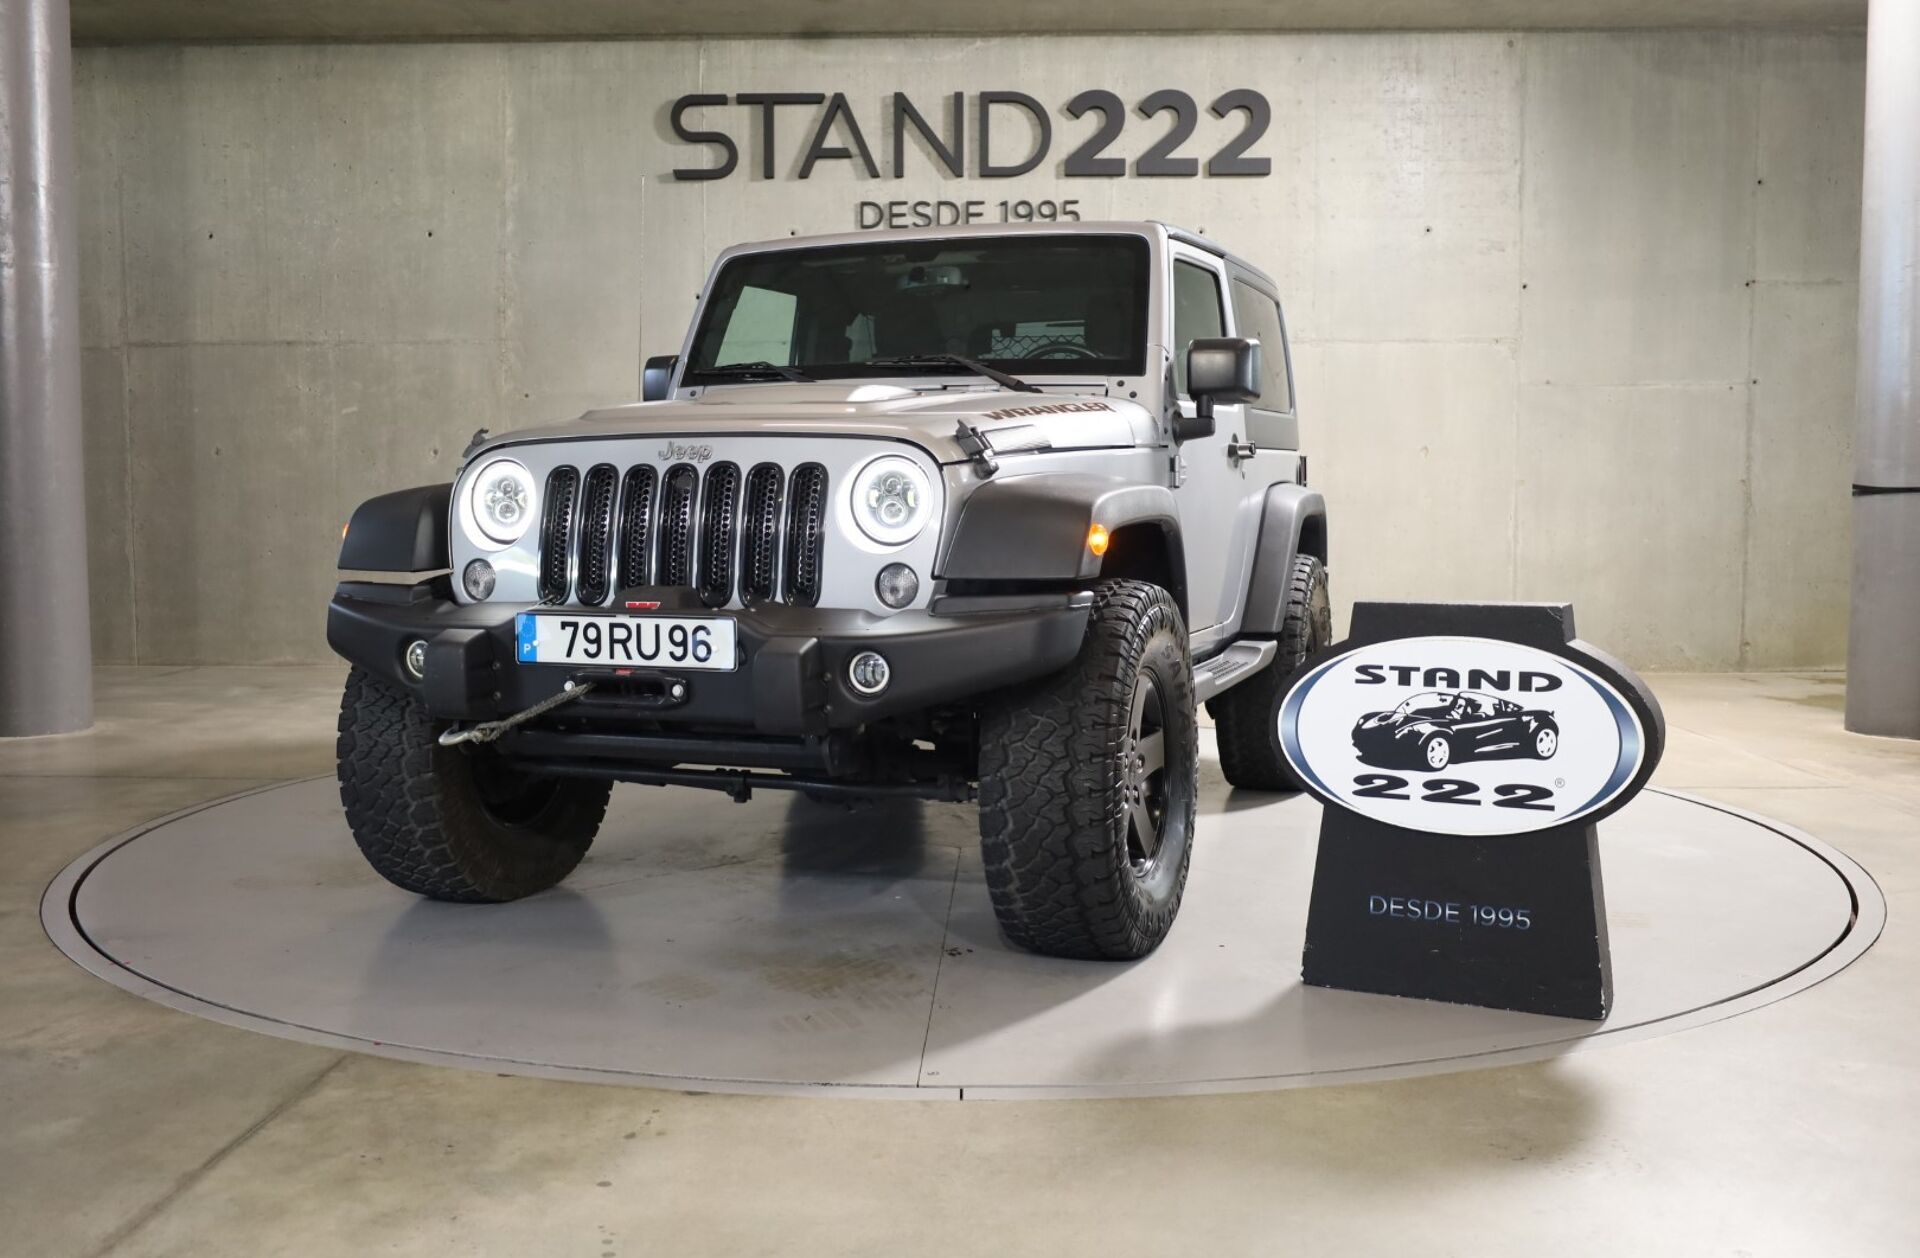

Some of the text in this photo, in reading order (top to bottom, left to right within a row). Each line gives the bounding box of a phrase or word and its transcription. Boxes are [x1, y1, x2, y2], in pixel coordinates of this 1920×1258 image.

[859, 199, 1081, 229] DESDE 1995
[983, 402, 1117, 421] WRANGLER
[658, 440, 713, 464] Jeep
[523, 643, 531, 655] P
[1354, 664, 1563, 693] STAND
[1352, 773, 1556, 812] 222
[1369, 895, 1532, 930] DESDE 1995
